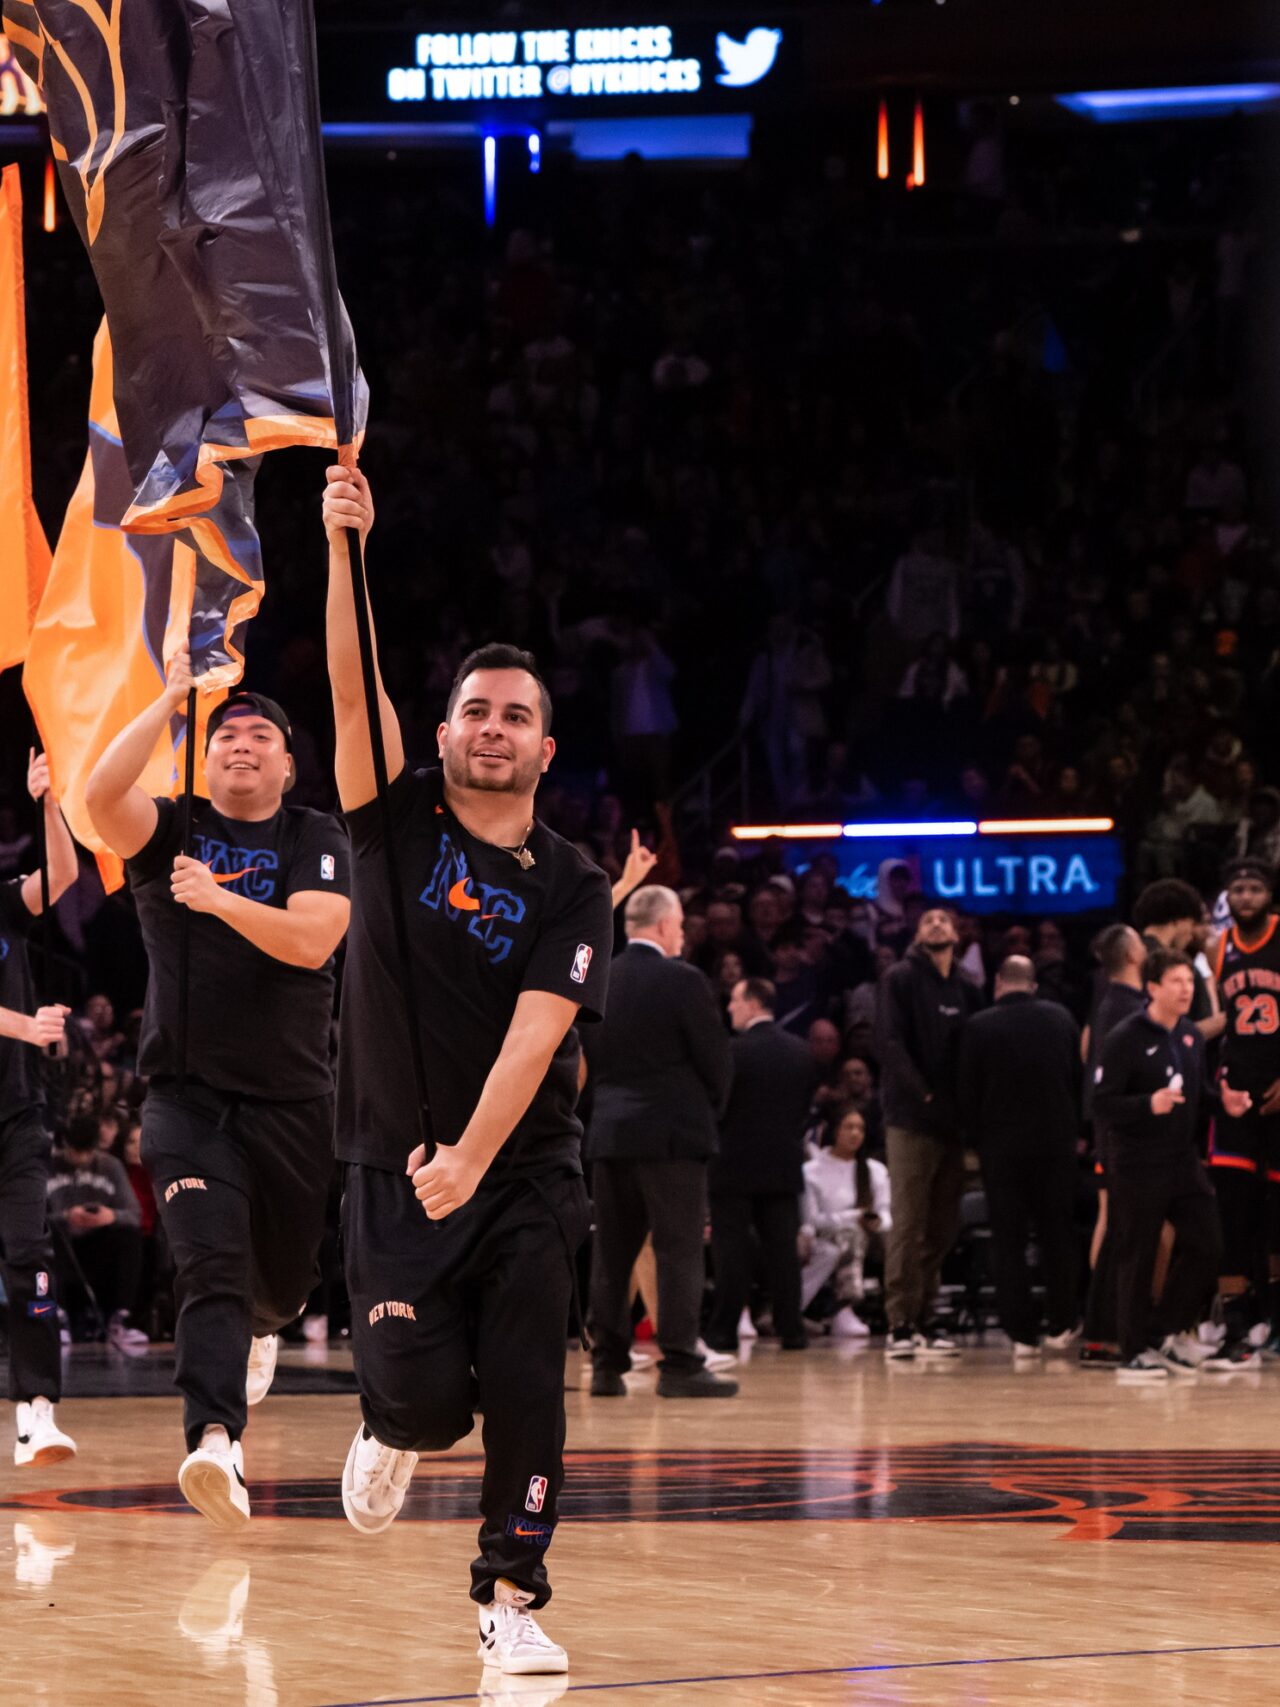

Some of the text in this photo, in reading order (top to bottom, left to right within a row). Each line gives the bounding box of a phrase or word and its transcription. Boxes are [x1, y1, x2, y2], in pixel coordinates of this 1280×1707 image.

[417, 25, 672, 66] FOLLOW THE KNICKS
[388, 59, 701, 101] ON TWITTER @NYKNICKS
[933, 855, 1100, 897] ULTRA
[1235, 993, 1279, 1035] 23
[369, 1301, 417, 1327] NEW YORK
